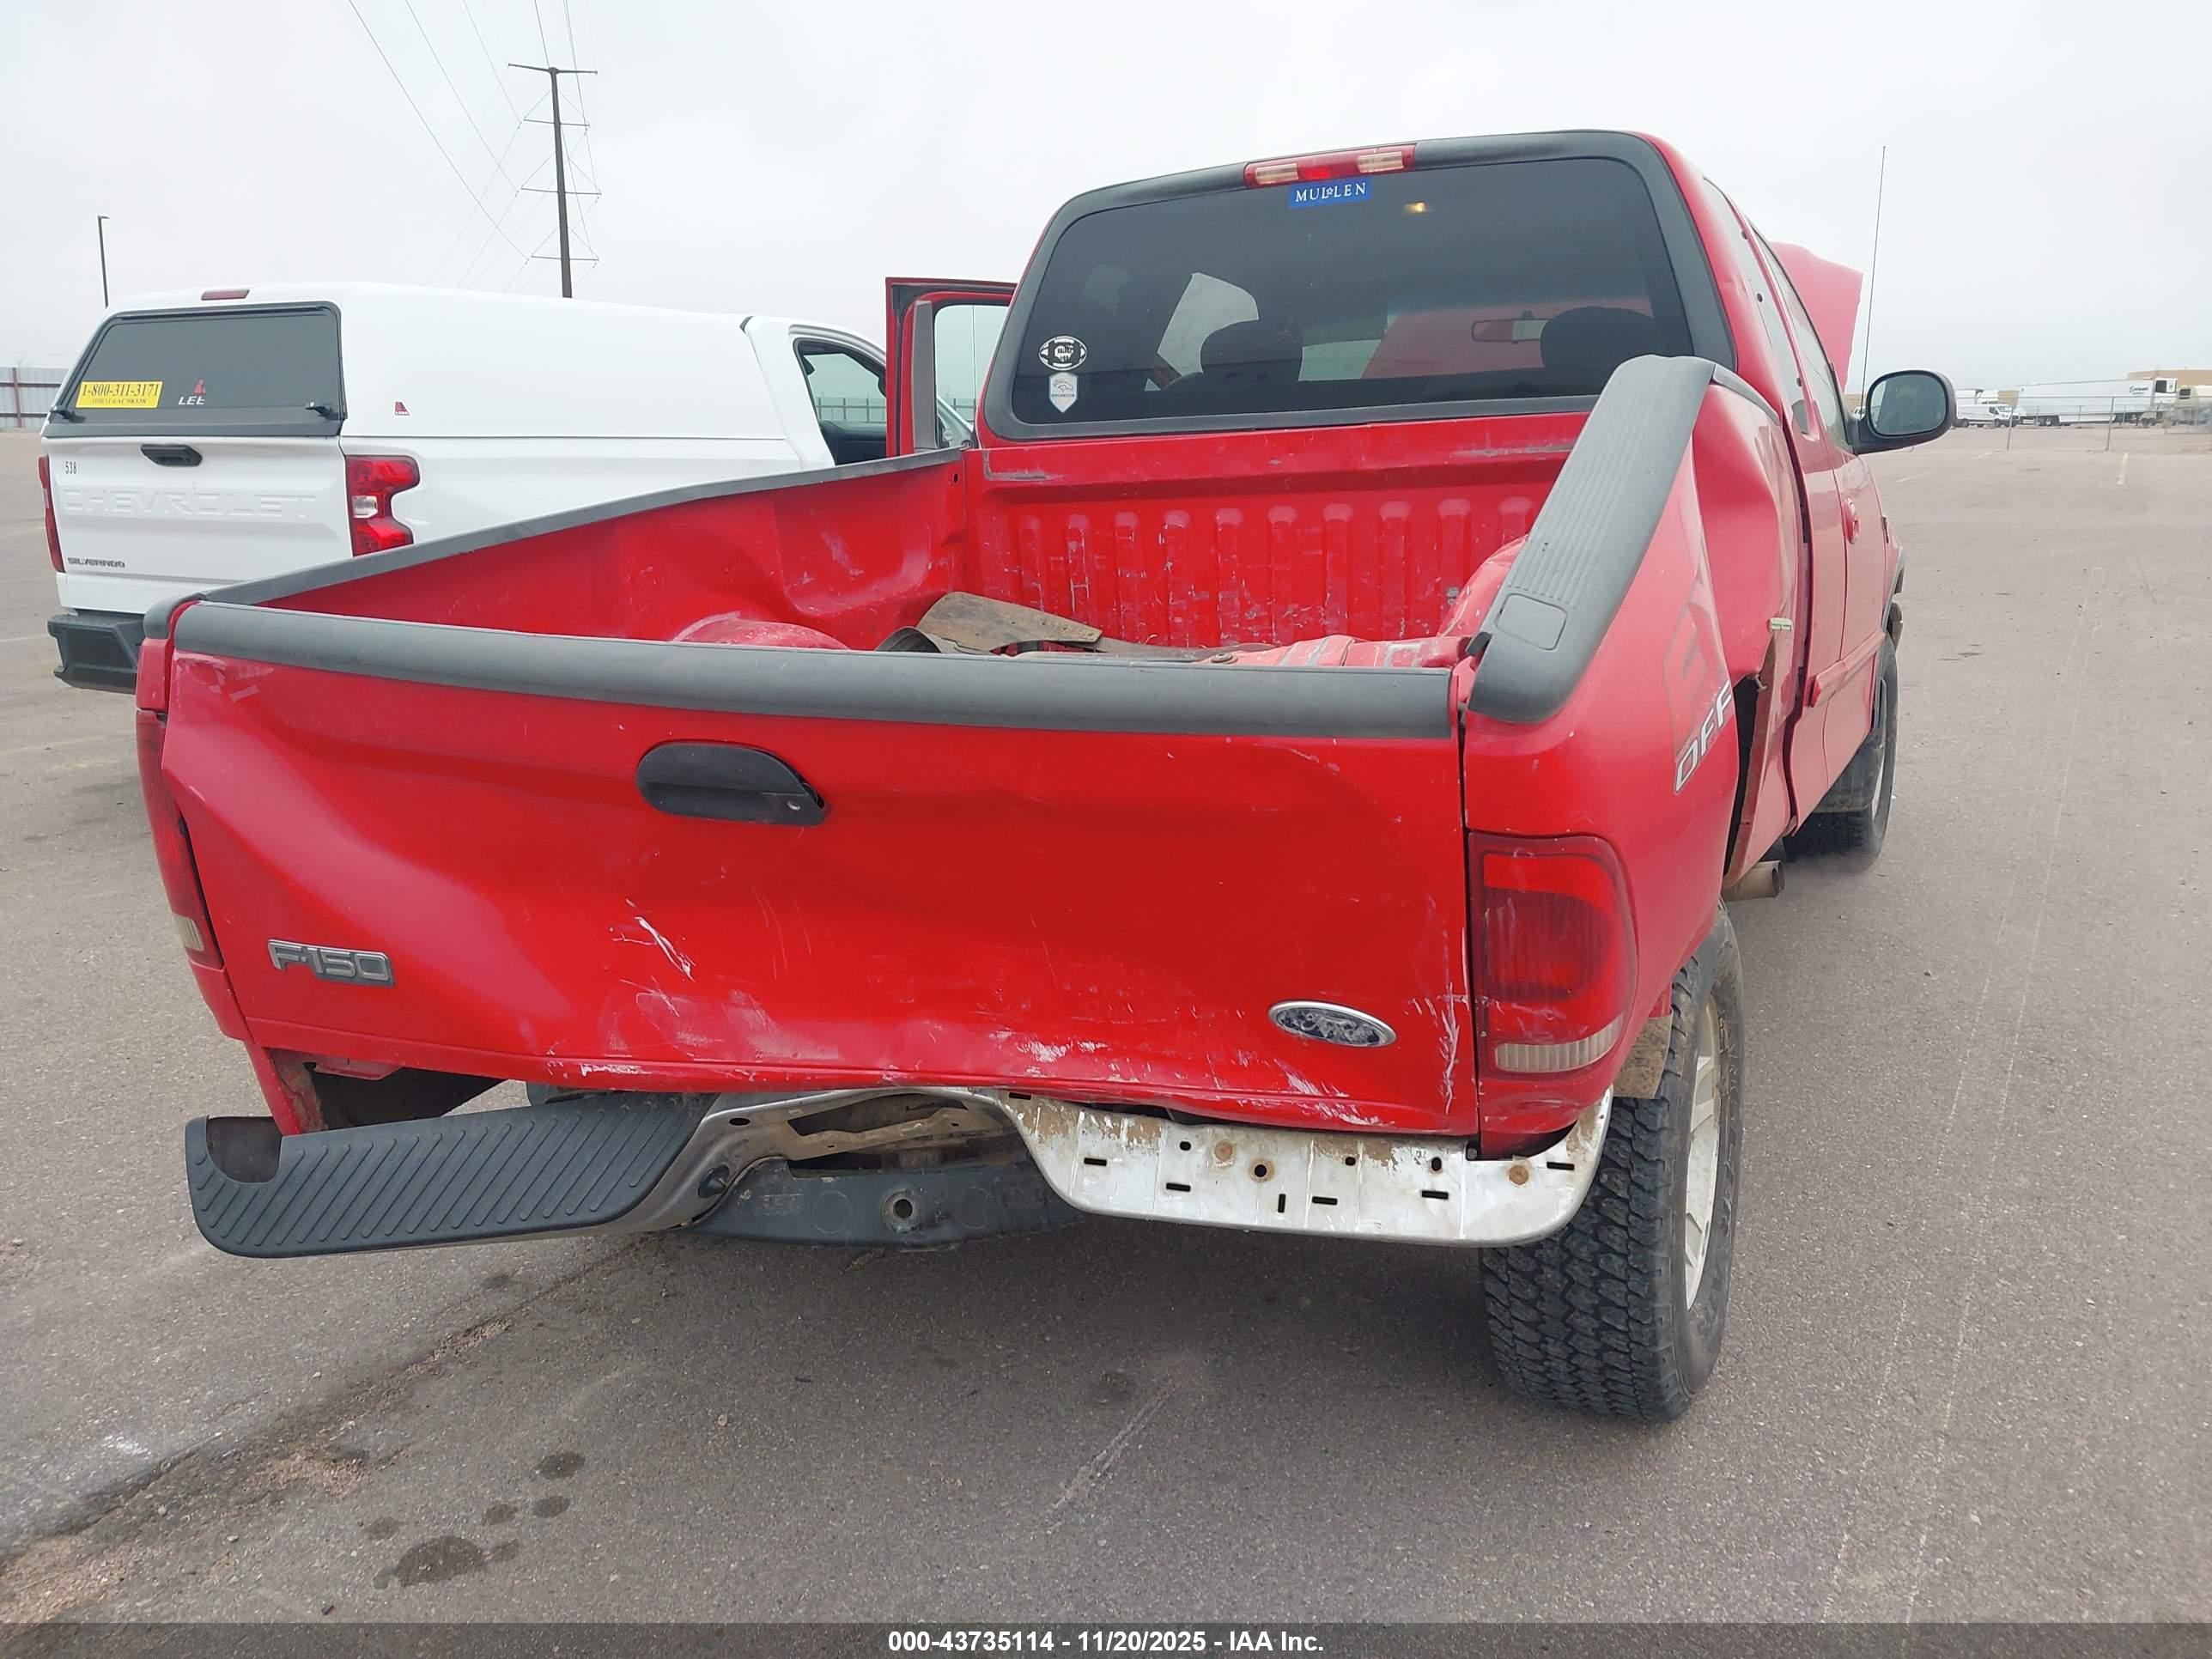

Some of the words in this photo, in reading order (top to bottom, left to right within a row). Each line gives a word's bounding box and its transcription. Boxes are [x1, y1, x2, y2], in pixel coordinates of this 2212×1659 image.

[1295, 182, 1366, 202] MULLEN
[82, 383, 158, 397] 1-800-311-3171
[65, 461, 77, 474] 538
[63, 489, 315, 517] CHEVROLET
